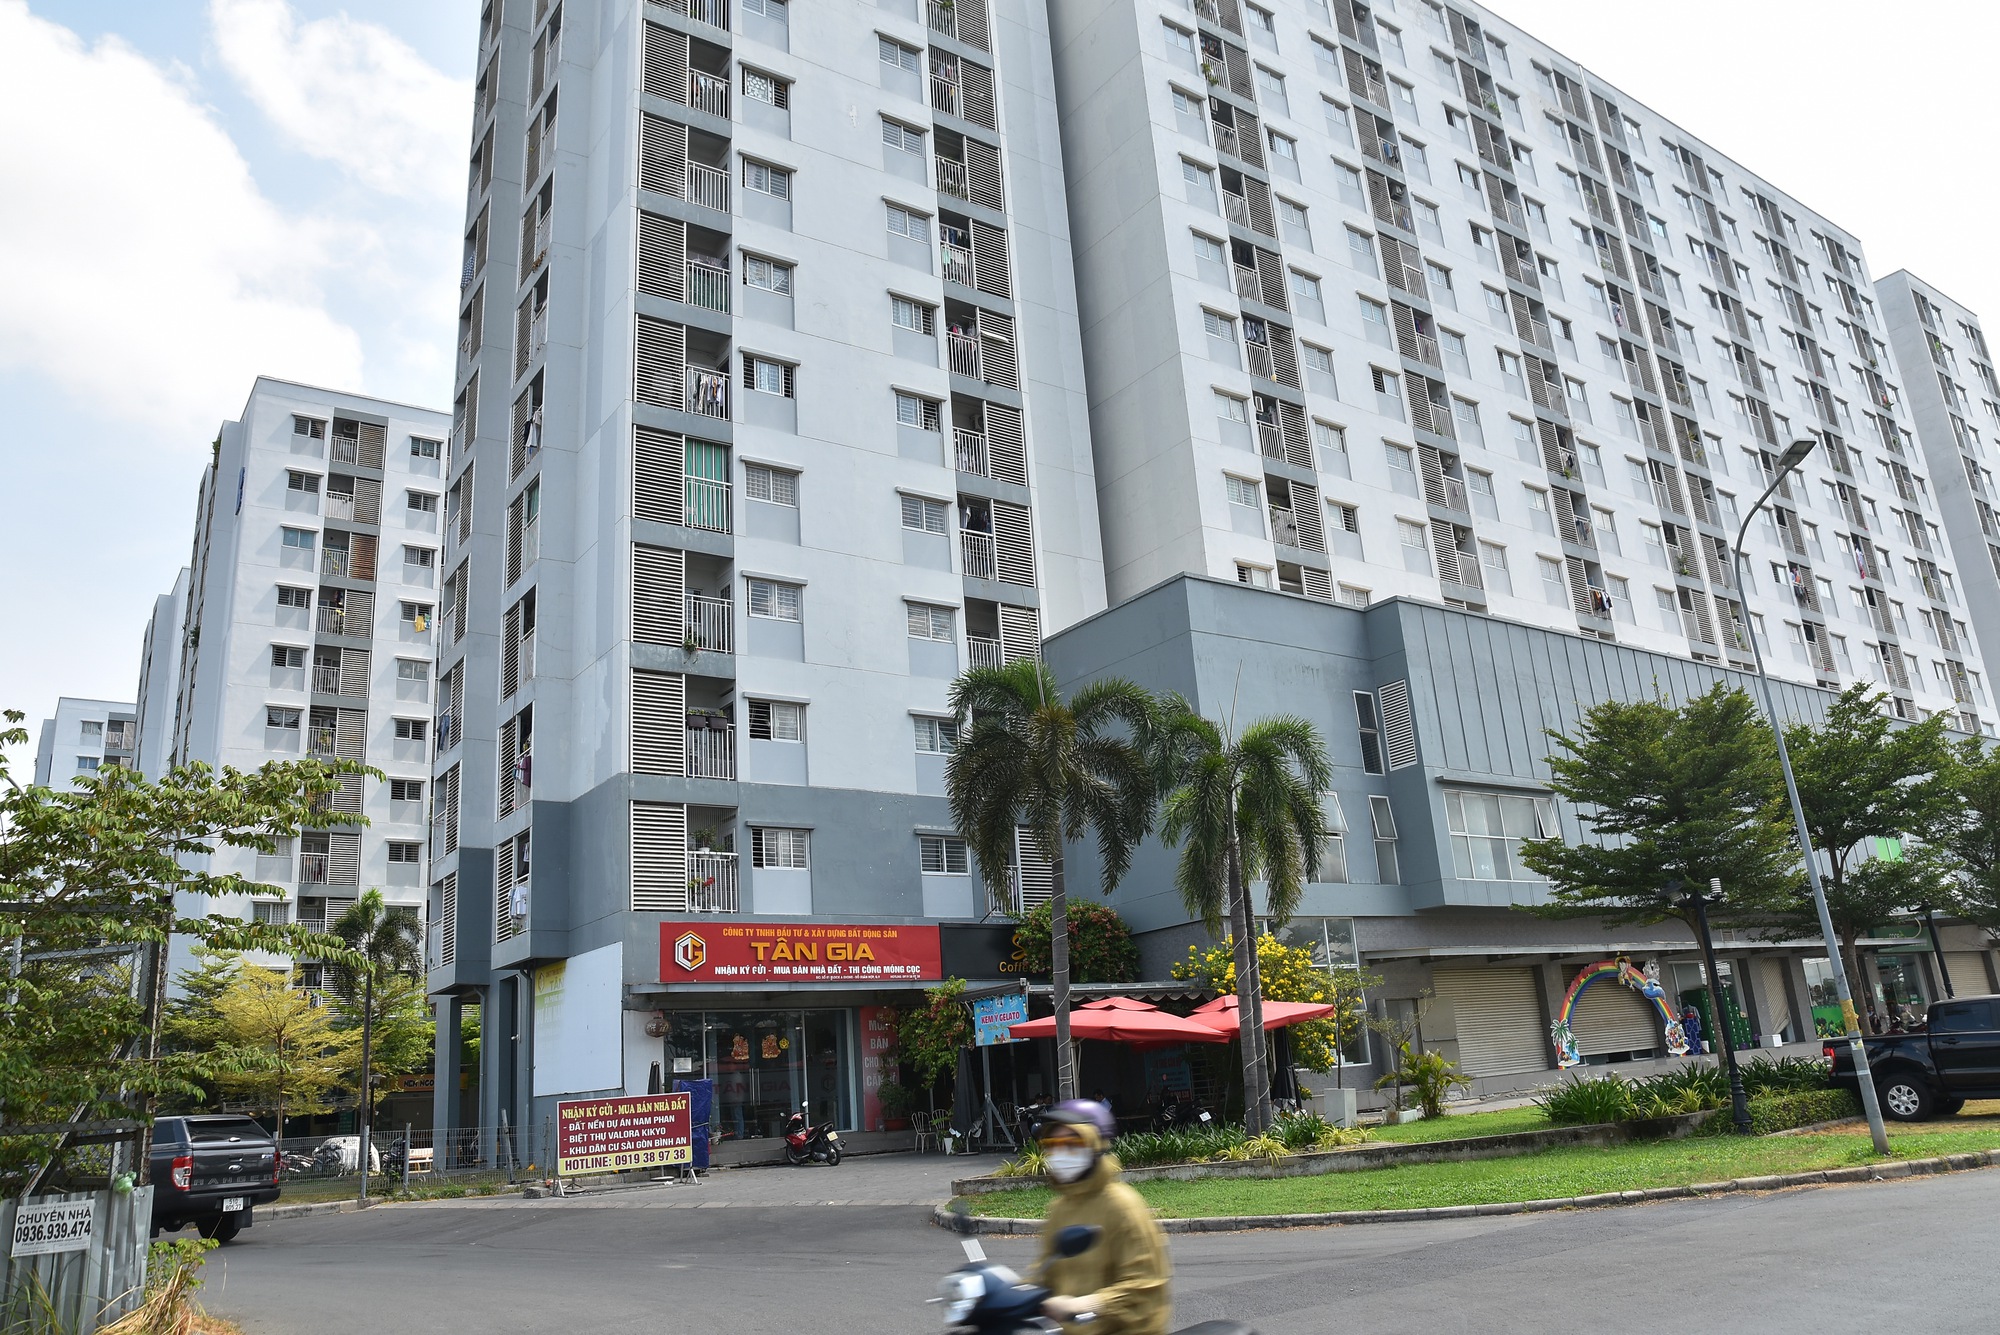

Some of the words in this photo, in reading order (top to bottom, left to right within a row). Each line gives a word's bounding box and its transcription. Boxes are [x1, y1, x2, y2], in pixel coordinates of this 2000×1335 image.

[723, 927, 743, 937] CÔNG
[745, 929, 754, 937] TY
[756, 929, 775, 937] TNHH
[776, 926, 792, 937] ĐẦU
[793, 929, 804, 937] TƯ
[804, 929, 810, 937] &
[811, 927, 826, 938] XÂY
[827, 929, 846, 939] DỰNG
[848, 926, 862, 938] BẤT
[750, 937, 818, 961] TÂN
[826, 942, 875, 961] GIA
[715, 964, 737, 976] NHẬN
[739, 964, 750, 975] KÝ
[752, 964, 766, 975] GỬI
[773, 966, 791, 974] MUA
[792, 964, 808, 974] BÁN
[810, 963, 826, 974] NHÀ
[827, 963, 842, 974] ĐẤT
[849, 965, 860, 974] THI
[861, 963, 882, 974] CÔNG
[883, 963, 905, 974] MÓNG
[906, 965, 920, 975] CỌC
[981, 1015, 994, 1024] KEM
[999, 1011, 1020, 1022] GELATO
[870, 1035, 889, 1049] BÁN
[864, 1056, 879, 1068] CHO
[562, 1105, 585, 1120] NHẬN
[586, 1104, 598, 1118] KÝ
[599, 1102, 613, 1116] GỬI
[618, 1104, 635, 1115] MUA
[636, 1100, 651, 1114] BÁN
[653, 1099, 671, 1112] NHÀ
[671, 1096, 687, 1110] ĐẤT
[569, 1121, 586, 1132] ĐẤT
[606, 1118, 618, 1130] DỰ
[619, 1115, 631, 1127] ÁN
[633, 1116, 651, 1126] NAM
[653, 1114, 675, 1124] PHAN
[569, 1132, 588, 1144] BIỆT
[590, 1130, 607, 1142] THỰ
[607, 1129, 640, 1140] VALORA
[641, 1127, 666, 1137] KIKYO
[569, 1146, 587, 1155] KHU
[589, 1143, 607, 1154] DÂN
[608, 1142, 619, 1152] CƯ
[621, 1140, 635, 1151] SÀI
[636, 1138, 652, 1149] GÒN
[654, 1136, 674, 1147] BÌNH
[675, 1136, 687, 1145] AN
[565, 1156, 612, 1171] HOTLINE:
[615, 1153, 640, 1166] 0919
[643, 1151, 655, 1163] 38
[658, 1150, 671, 1162] 97
[673, 1149, 686, 1160] 38
[68, 1206, 92, 1220] NHÀ
[15, 1220, 92, 1243] 0936.939.474
